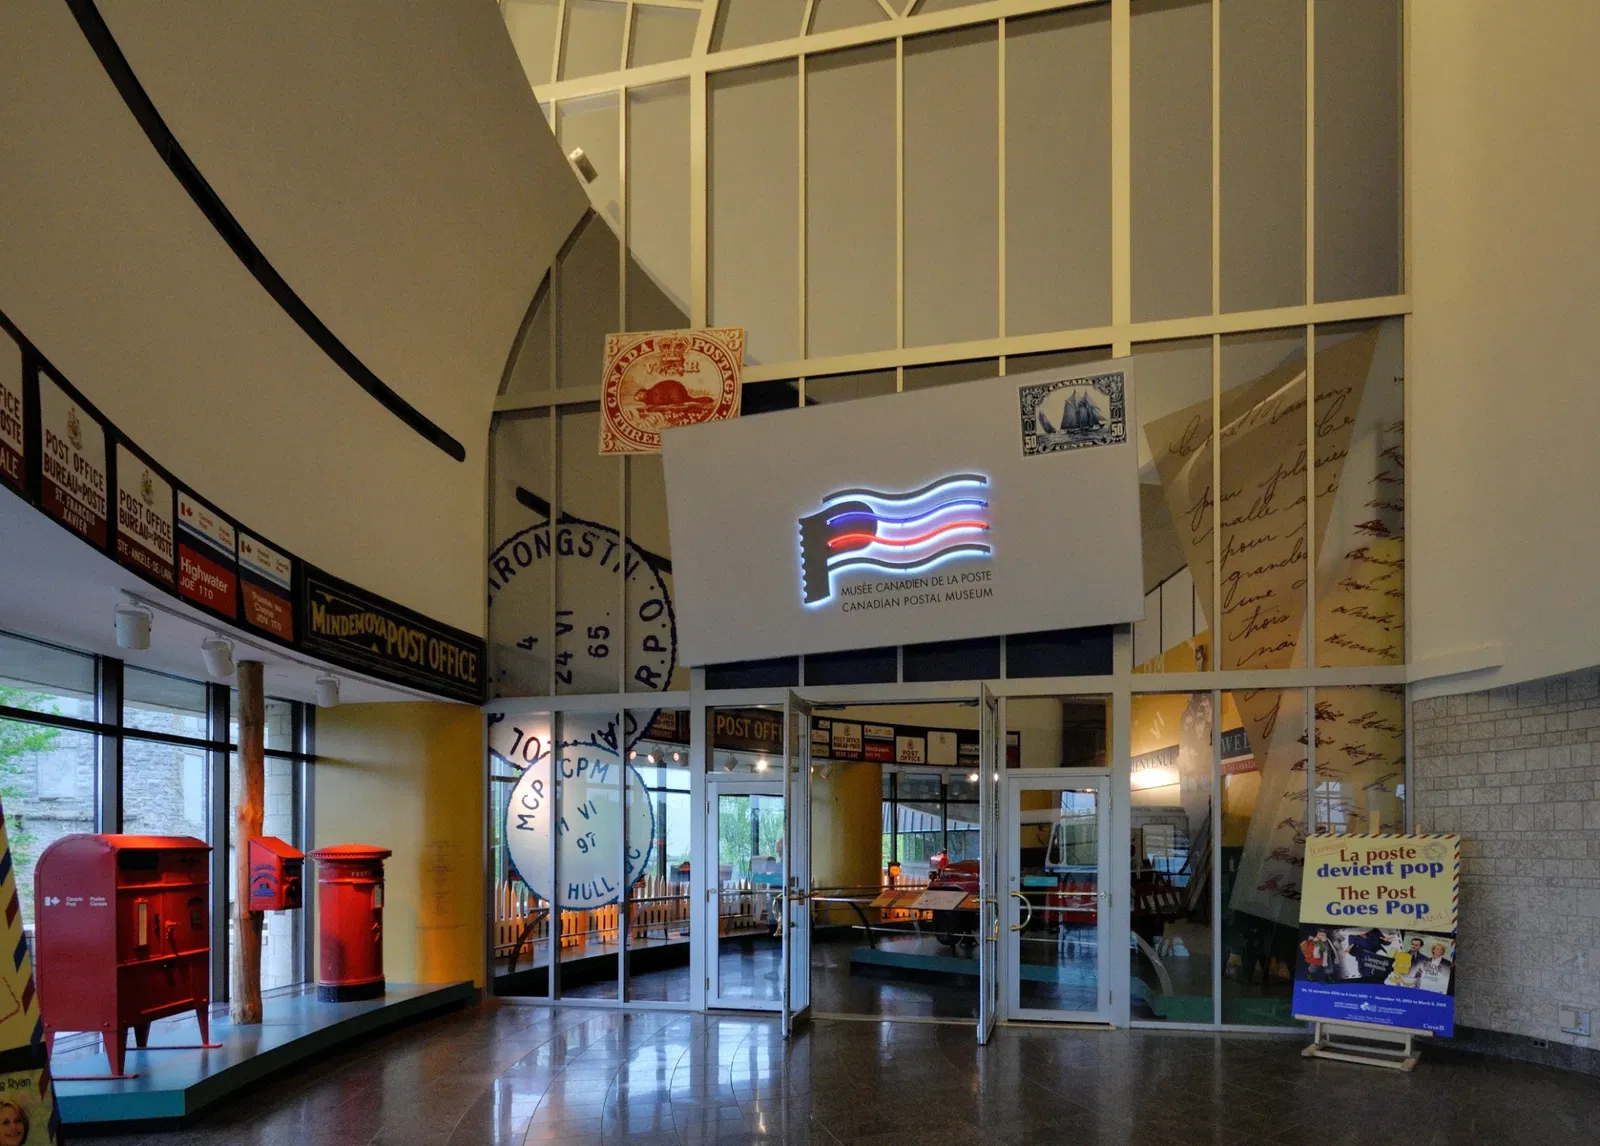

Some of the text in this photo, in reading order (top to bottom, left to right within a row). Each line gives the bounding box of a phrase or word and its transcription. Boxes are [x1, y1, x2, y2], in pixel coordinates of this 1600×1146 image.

[607, 343, 652, 408] CANADA
[694, 339, 734, 406] POSTAGE
[1025, 435, 1037, 448] 50
[1112, 423, 1123, 437] 50
[46, 428, 104, 492] POST OFFICE
[120, 488, 171, 540] POST OFFICE
[180, 556, 228, 593] Highwater
[841, 571, 992, 597] MUSÉE CANADIEN DE LA POSTE
[842, 587, 993, 613] CANADIAN POSTAL MUSEUM
[386, 620, 427, 666] POST
[429, 637, 477, 684] OFFICE
[717, 715, 751, 739] POST
[560, 757, 609, 783] CPM
[516, 779, 544, 831] MCP
[1340, 849, 1359, 862] La
[1366, 846, 1416, 865] poste
[1317, 861, 1444, 879] devient pop
[1337, 885, 1416, 900] The Post
[1326, 900, 1429, 919] Goes Pop
